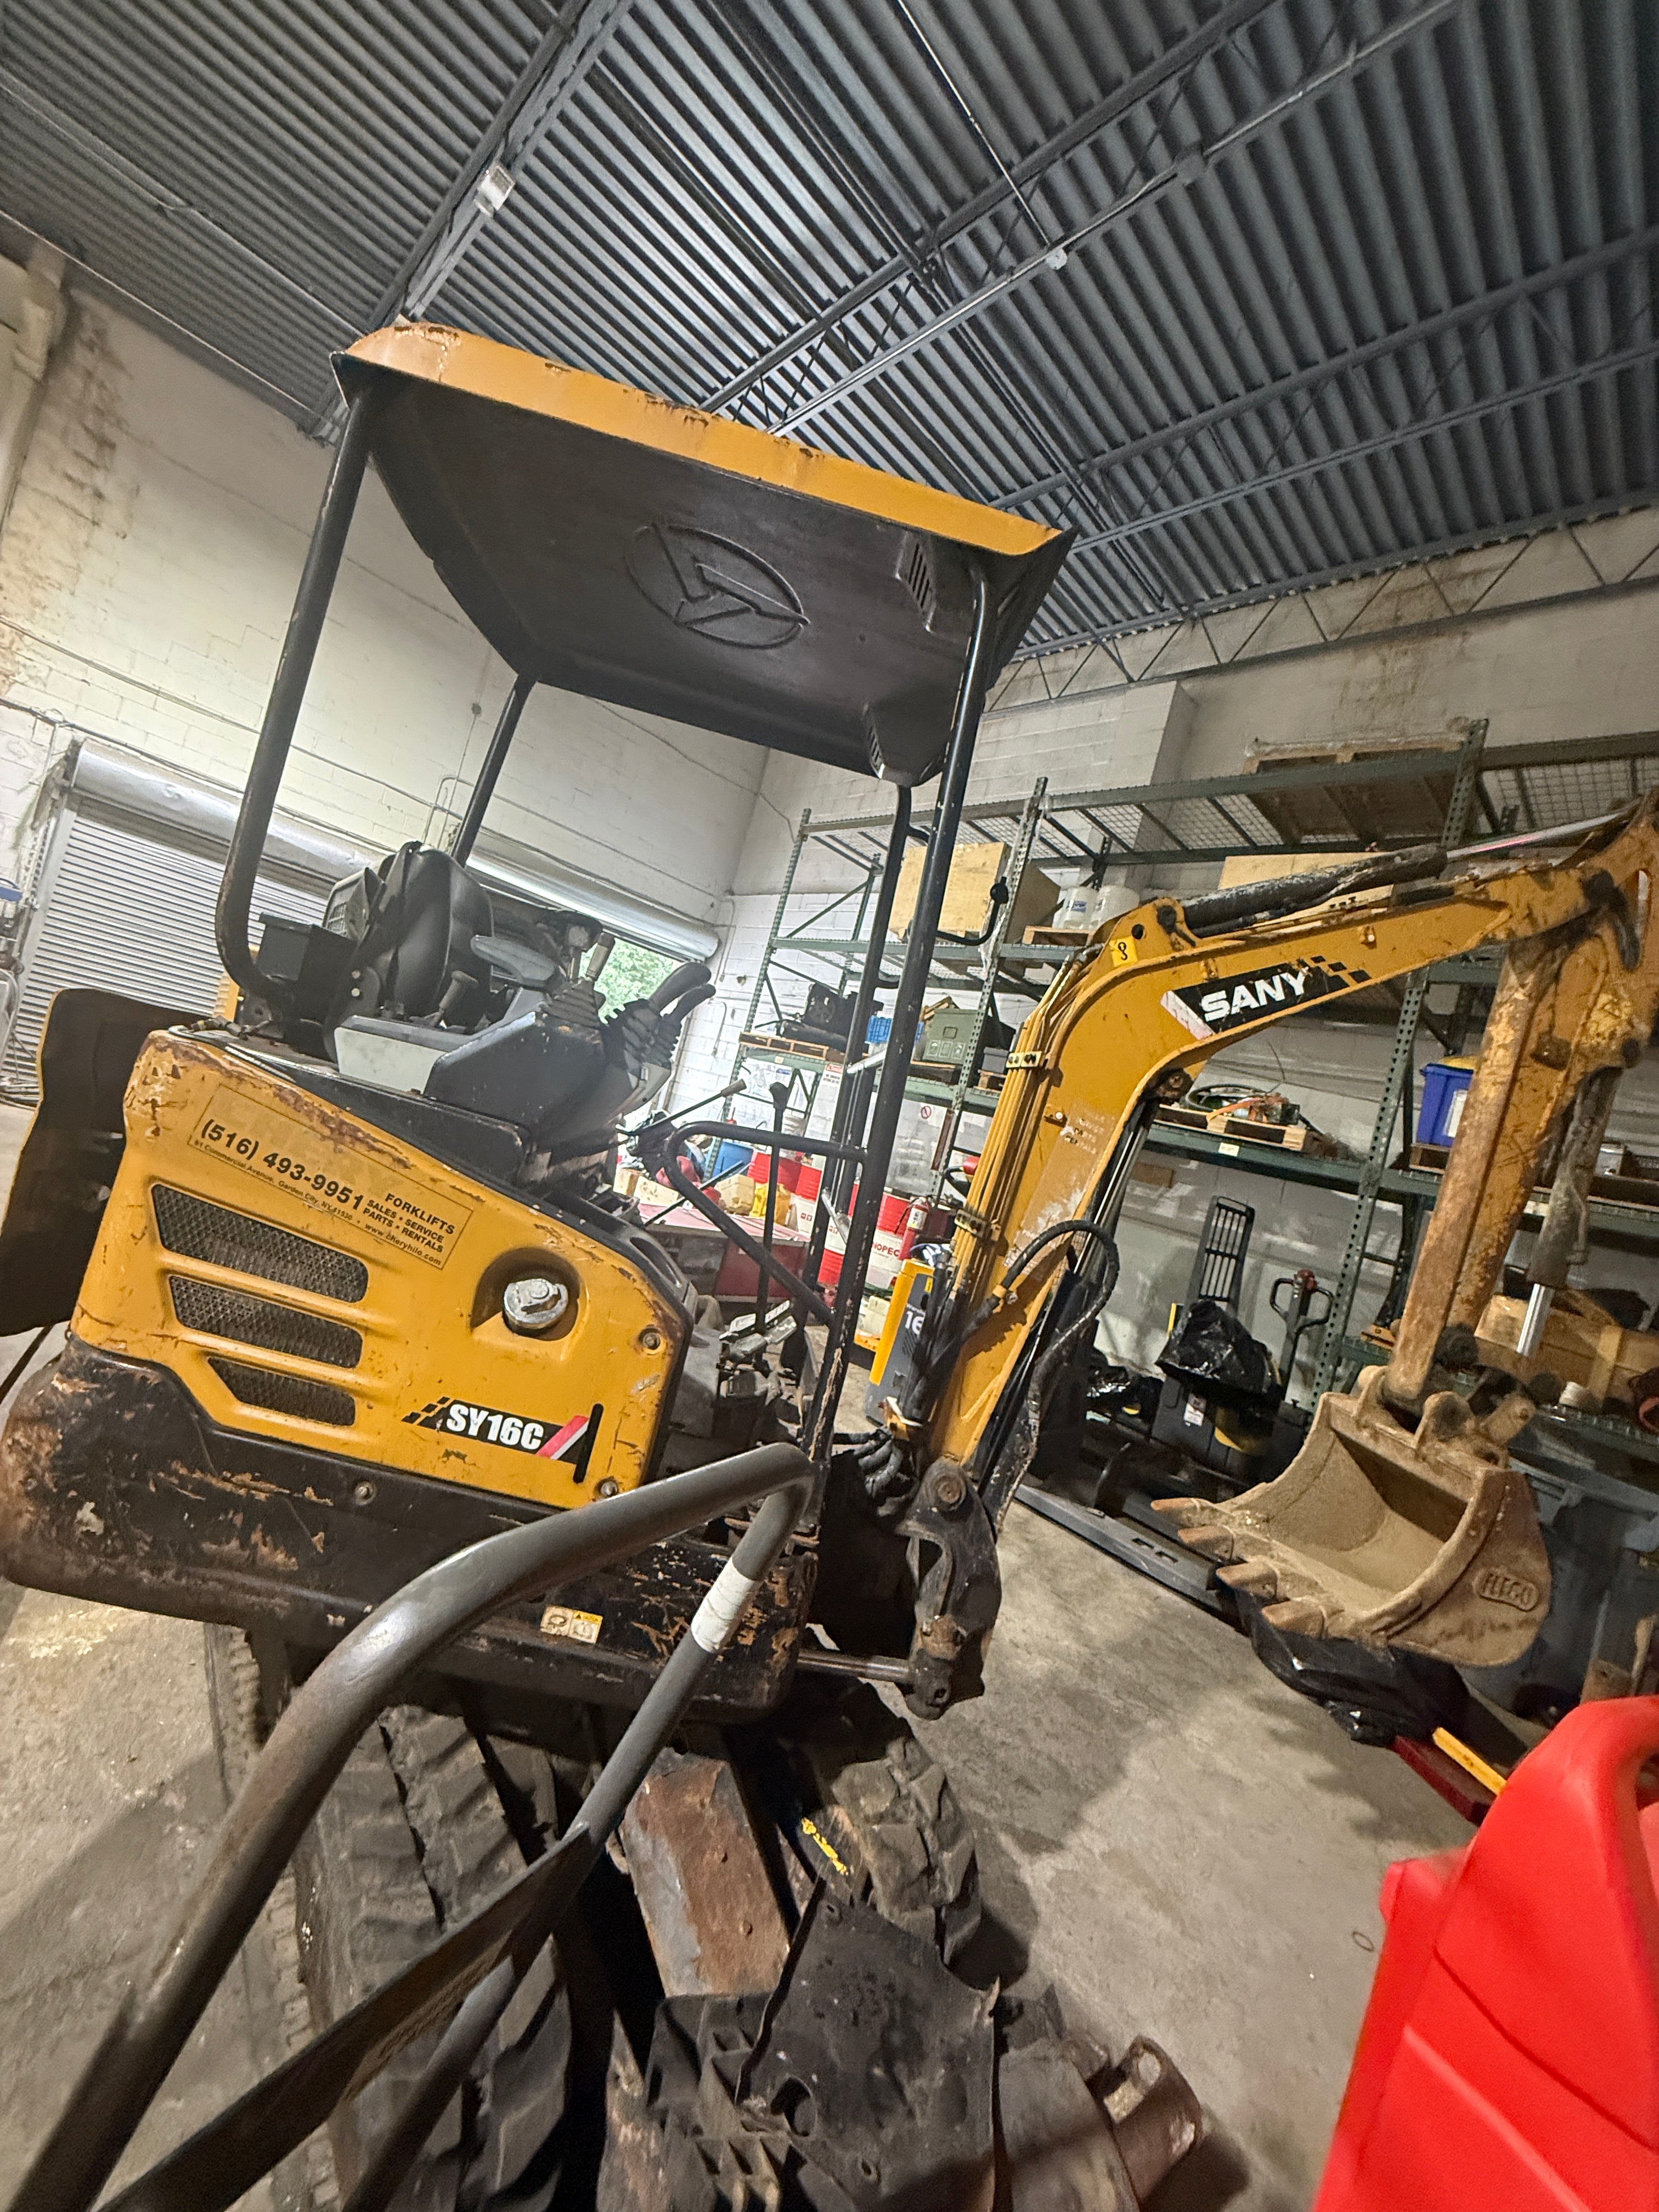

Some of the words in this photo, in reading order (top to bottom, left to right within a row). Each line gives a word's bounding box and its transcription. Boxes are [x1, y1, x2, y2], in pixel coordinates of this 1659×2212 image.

[1201, 967, 1309, 1022] SANY
[201, 1119, 259, 1160] (516)
[263, 1153, 364, 1210] 493-9951
[278, 1180, 303, 1196] Garden
[363, 1207, 394, 1228] PARTS
[401, 1227, 444, 1252] RENTALS
[367, 1199, 397, 1219] SALES
[404, 1218, 444, 1243] SERVICE
[385, 1193, 455, 1234] FORKLIFTS
[446, 1404, 544, 1450] SY16C
